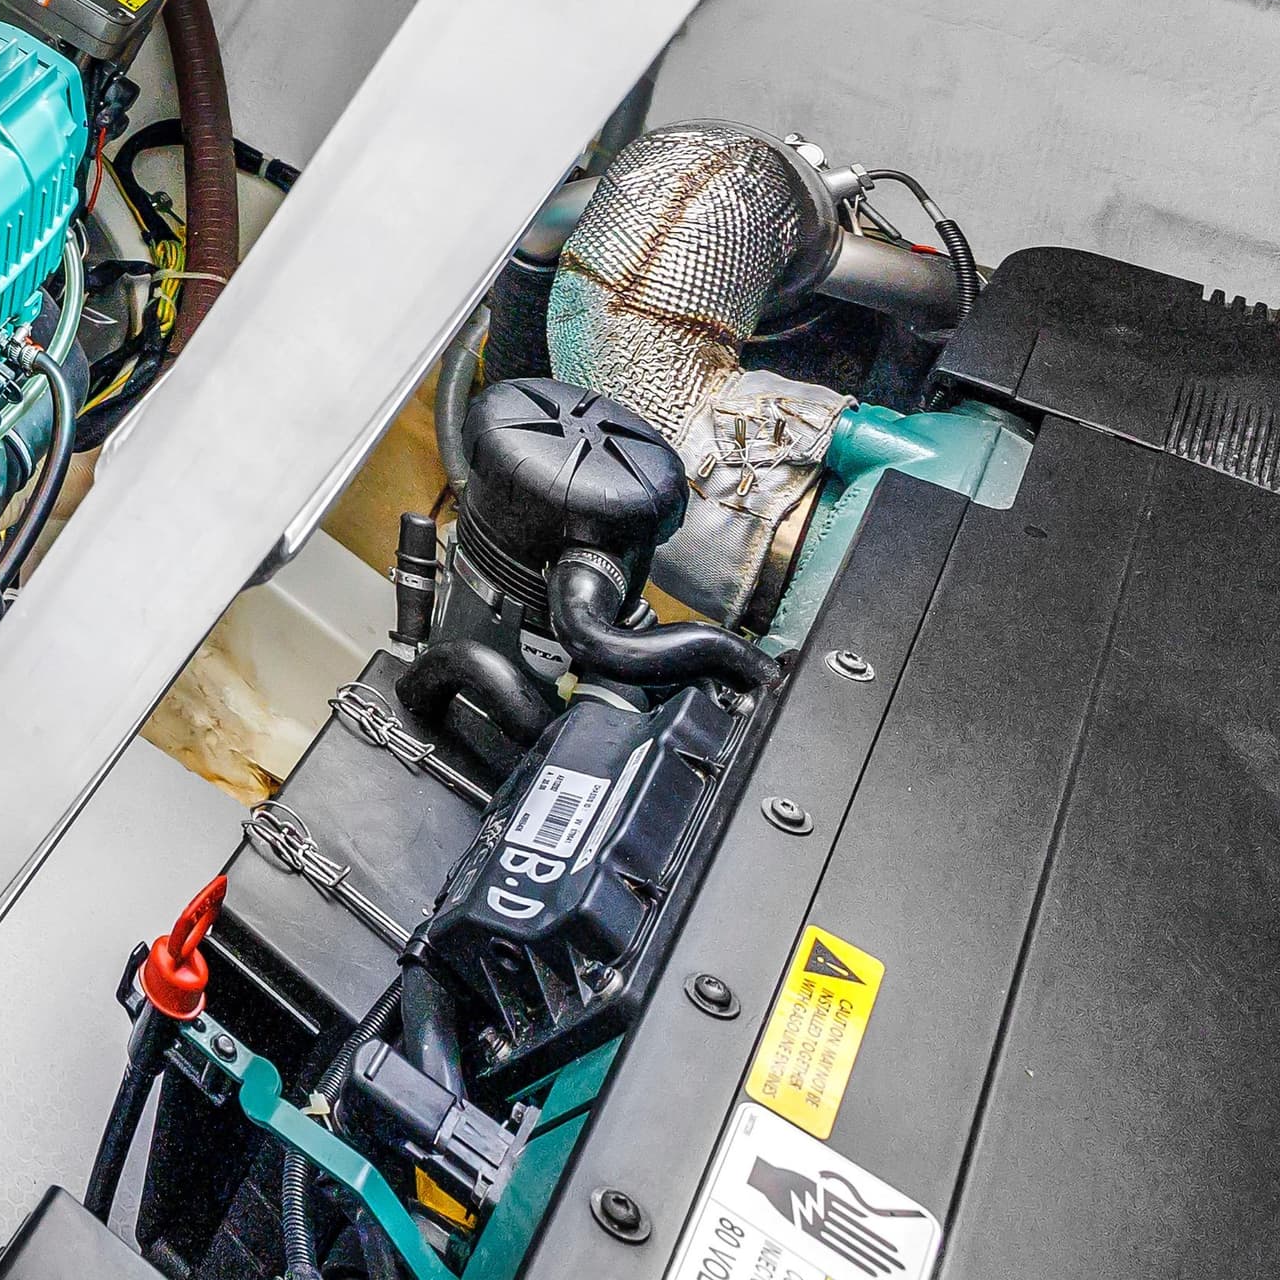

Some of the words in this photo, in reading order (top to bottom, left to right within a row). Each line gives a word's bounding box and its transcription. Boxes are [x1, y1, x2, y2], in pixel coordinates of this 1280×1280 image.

[486, 848, 565, 920] B.D
[797, 977, 815, 1004] WITH
[806, 986, 834, 1039] INSTALLED
[777, 1002, 805, 1055] GASOLINE
[788, 1036, 817, 1090] TOGETHER
[714, 1217, 745, 1249] 80
